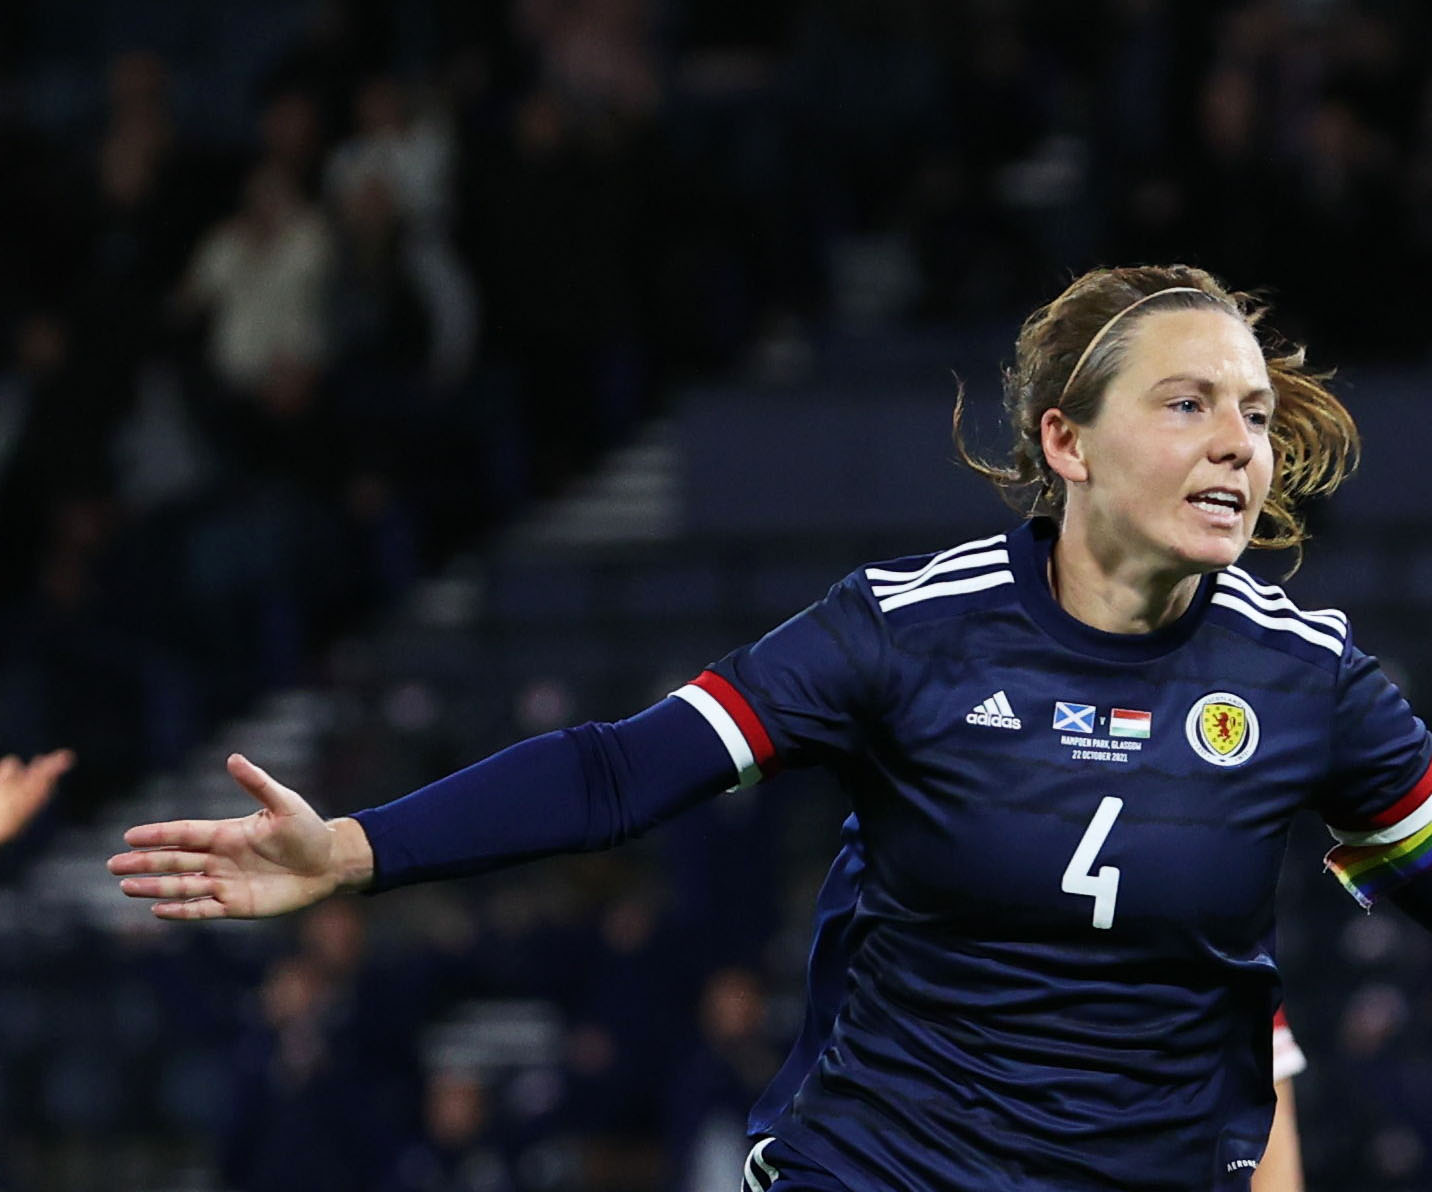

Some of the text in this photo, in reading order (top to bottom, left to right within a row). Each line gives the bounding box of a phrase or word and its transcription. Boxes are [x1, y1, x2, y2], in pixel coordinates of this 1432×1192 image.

[965, 713, 1022, 730] adidas
[1061, 735, 1142, 751] HAMPDEN PARK, GLASGOW
[1072, 750, 1128, 762] 22 OCTOBER 2021
[1061, 796, 1124, 930] 4
